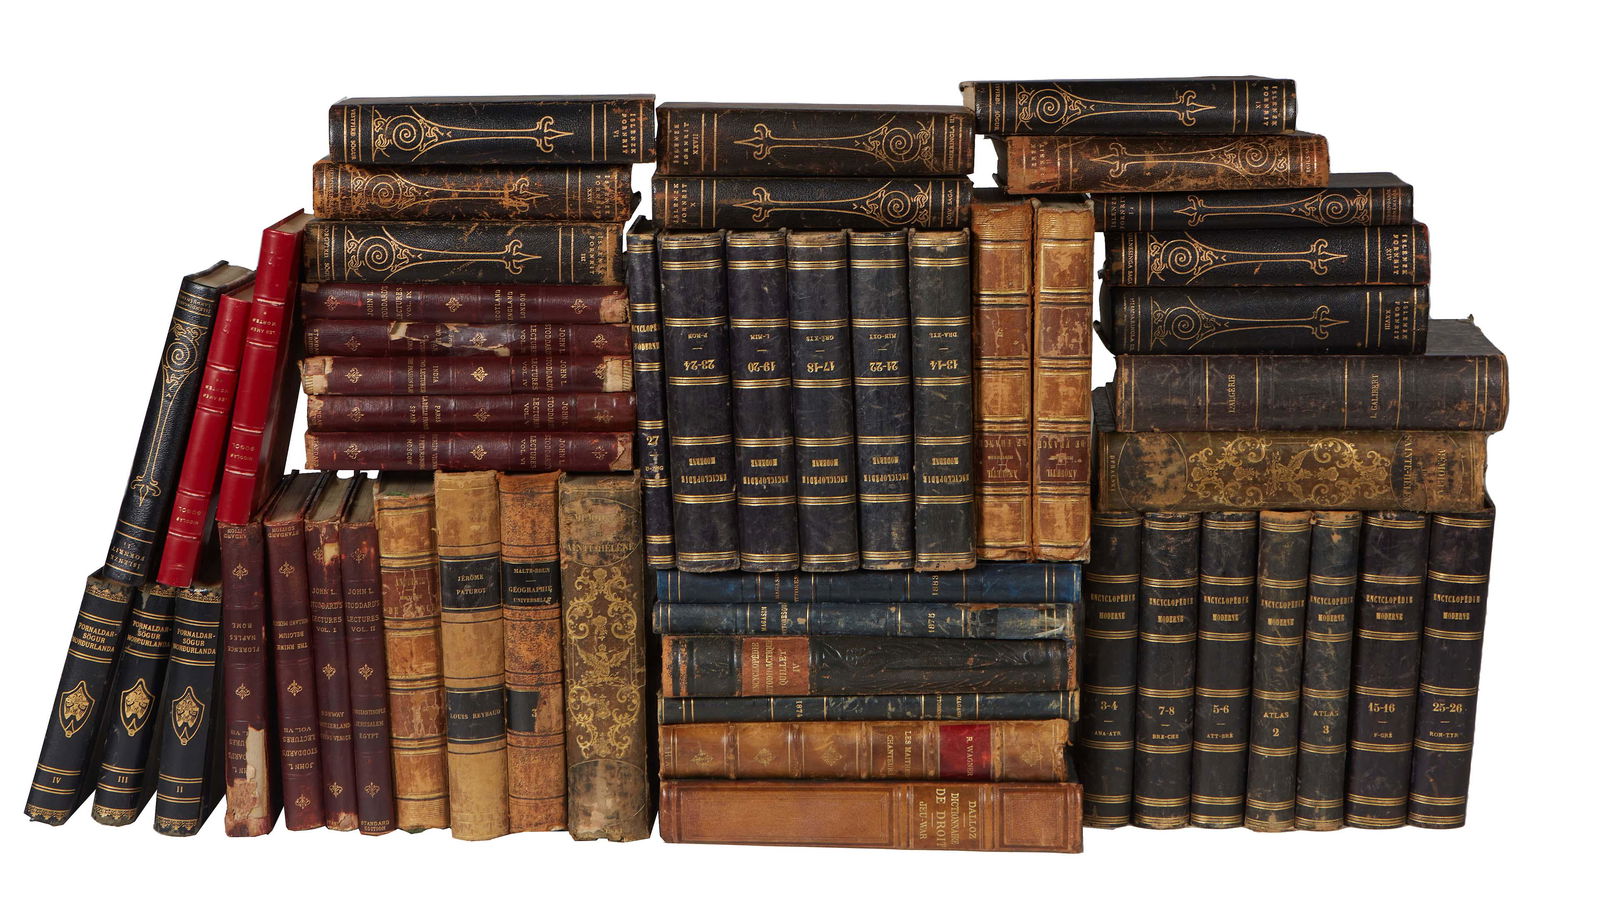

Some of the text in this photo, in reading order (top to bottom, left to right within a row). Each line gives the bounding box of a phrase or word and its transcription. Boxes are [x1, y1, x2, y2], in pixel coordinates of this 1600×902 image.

[1255, 100, 1262, 110] IX
[1262, 85, 1270, 127] FORNRIT
[613, 129, 620, 138] VI
[621, 113, 629, 154] FORNRIT
[1392, 234, 1400, 275] FORNRIT
[395, 287, 403, 320] LECTURES
[683, 359, 715, 371] 23-24
[747, 361, 777, 372] 19-20
[806, 362, 836, 373] 17-18
[869, 361, 899, 372] 21-22
[929, 359, 958, 371] 13-14
[530, 357, 539, 391] LECTURES
[561, 401, 569, 418] JOHN
[646, 435, 660, 446] 27
[1075, 440, 1085, 448] DE
[231, 442, 256, 452] GOGOL
[558, 438, 566, 458] JOHN
[688, 457, 716, 466] MODERNE
[750, 458, 778, 467] MODERNE
[811, 458, 839, 467] MODERNE
[872, 456, 899, 464] MODERNE
[931, 457, 959, 465] MODERNE
[680, 472, 727, 484] ENCYCLOPÉDIE
[743, 474, 789, 486] ENCYCLOPÉDIE
[802, 474, 848, 485] ENCYCLOPÉDIE
[862, 472, 909, 484] ENCYCLOPÉDIE
[922, 473, 970, 484] ENCYCLOPÉDIE
[931, 575, 939, 596] 1883
[311, 588, 329, 596] JOHN
[347, 588, 367, 596] JOHN
[456, 587, 486, 596] PATUROT
[1090, 593, 1136, 603] ENCYCLOPÉDIE
[1149, 597, 1194, 607] ENCYCLOPÉDIE
[1203, 595, 1249, 605] ENCYCLOPÉDIE
[1310, 595, 1354, 605] ENCYCLOPÉDIE
[1366, 593, 1414, 604] ENCYCLOPÉDIE
[1433, 593, 1481, 603] ENCYCLOPÉDIE
[1261, 599, 1304, 609] ENCYCLOPÉDIE
[346, 614, 380, 623] LECTURES
[760, 606, 768, 632] MAGASIN
[1098, 611, 1126, 620] MODERNE
[1156, 615, 1185, 624] MODERNE
[1212, 613, 1240, 622] MODERNE
[1317, 613, 1345, 623] MODERNE
[1375, 612, 1404, 621] MODERNE
[1442, 611, 1470, 620] MODERNE
[1267, 618, 1295, 627] MODERNE
[82, 632, 106, 644] SÖGUR
[137, 629, 161, 640] SÖGUR
[278, 630, 305, 639] BELGIUM
[182, 637, 205, 646] SÖGUR
[227, 645, 260, 653] FLORENCE
[778, 650, 787, 686] QUILLET
[792, 662, 800, 673] IV
[1100, 700, 1119, 711] 3-4
[1158, 705, 1176, 716] 7-8
[1212, 704, 1230, 714] 5-6
[1368, 702, 1396, 713] 15-16
[1432, 702, 1463, 713] 25-26
[449, 712, 468, 720] LOUIS
[1272, 727, 1280, 737] 2
[1323, 725, 1330, 734] 3
[282, 734, 316, 743] LECTURES
[359, 732, 379, 740] EGYPT
[904, 730, 912, 745] LES
[295, 762, 314, 770] JOHN
[966, 745, 974, 777] WAGNER
[117, 776, 129, 784] III
[918, 801, 928, 840] JEU-WAR
[936, 787, 946, 848] DE DROIT
[950, 792, 960, 845] DICTIONNAIRE
[968, 801, 977, 839] DALLOZ
